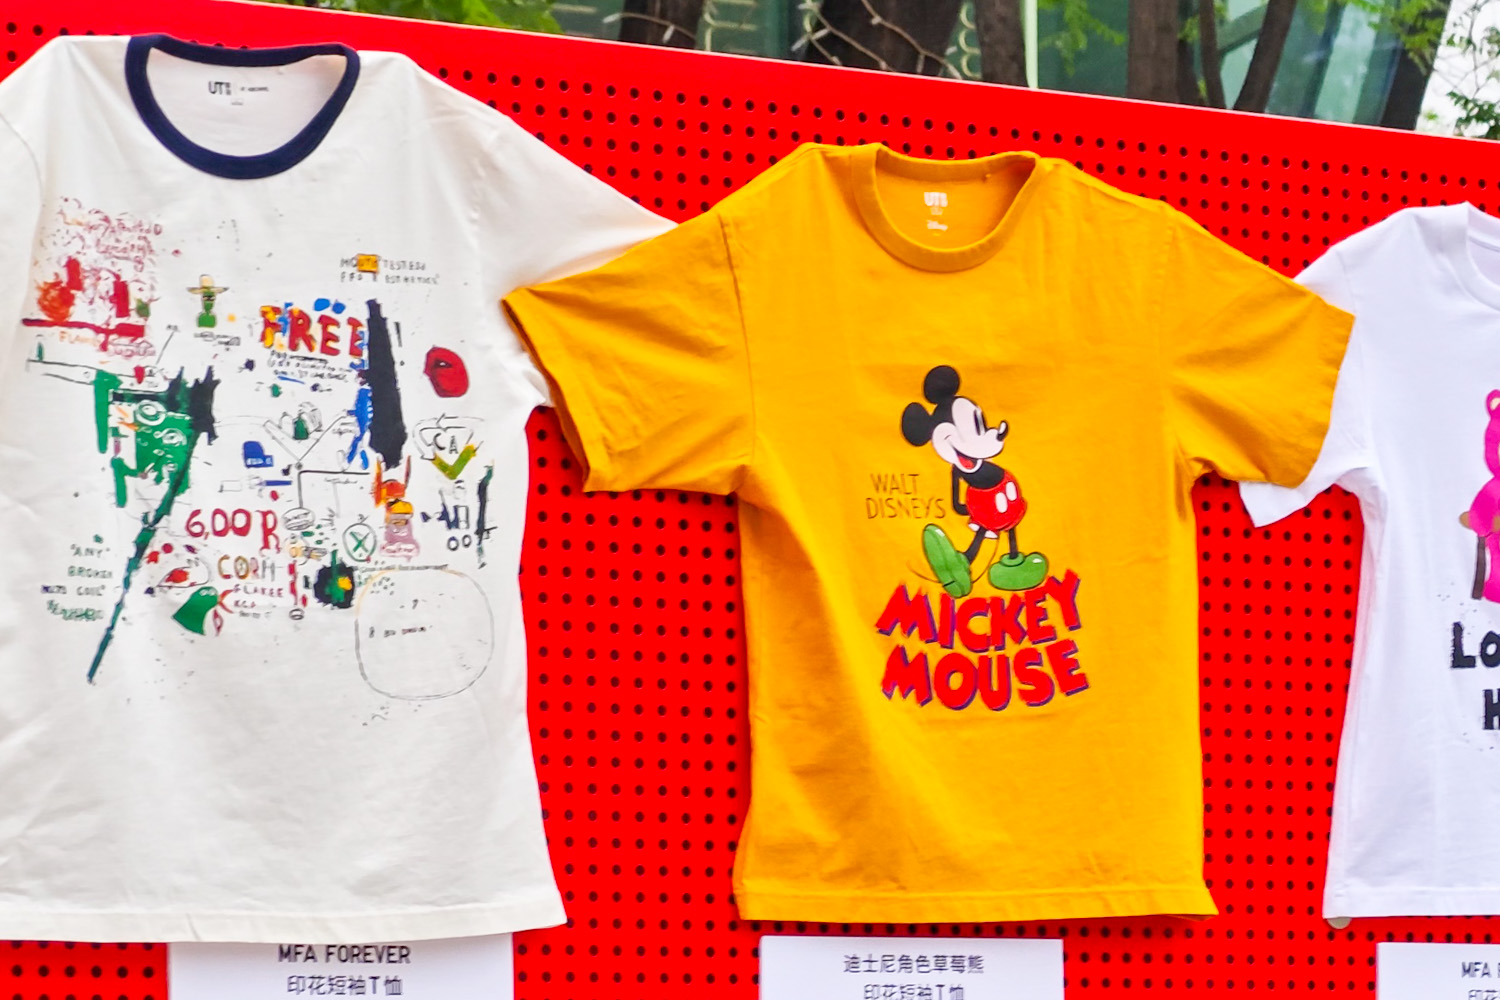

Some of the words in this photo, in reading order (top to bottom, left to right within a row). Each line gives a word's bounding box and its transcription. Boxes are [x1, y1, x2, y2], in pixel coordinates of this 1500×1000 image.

[871, 473, 920, 496] WALT
[876, 568, 1081, 653] MICKEY
[881, 639, 1089, 712] MOUSE
[279, 945, 318, 963] MFA
[325, 945, 411, 963] FOREVER
[1461, 962, 1491, 978] MFA
